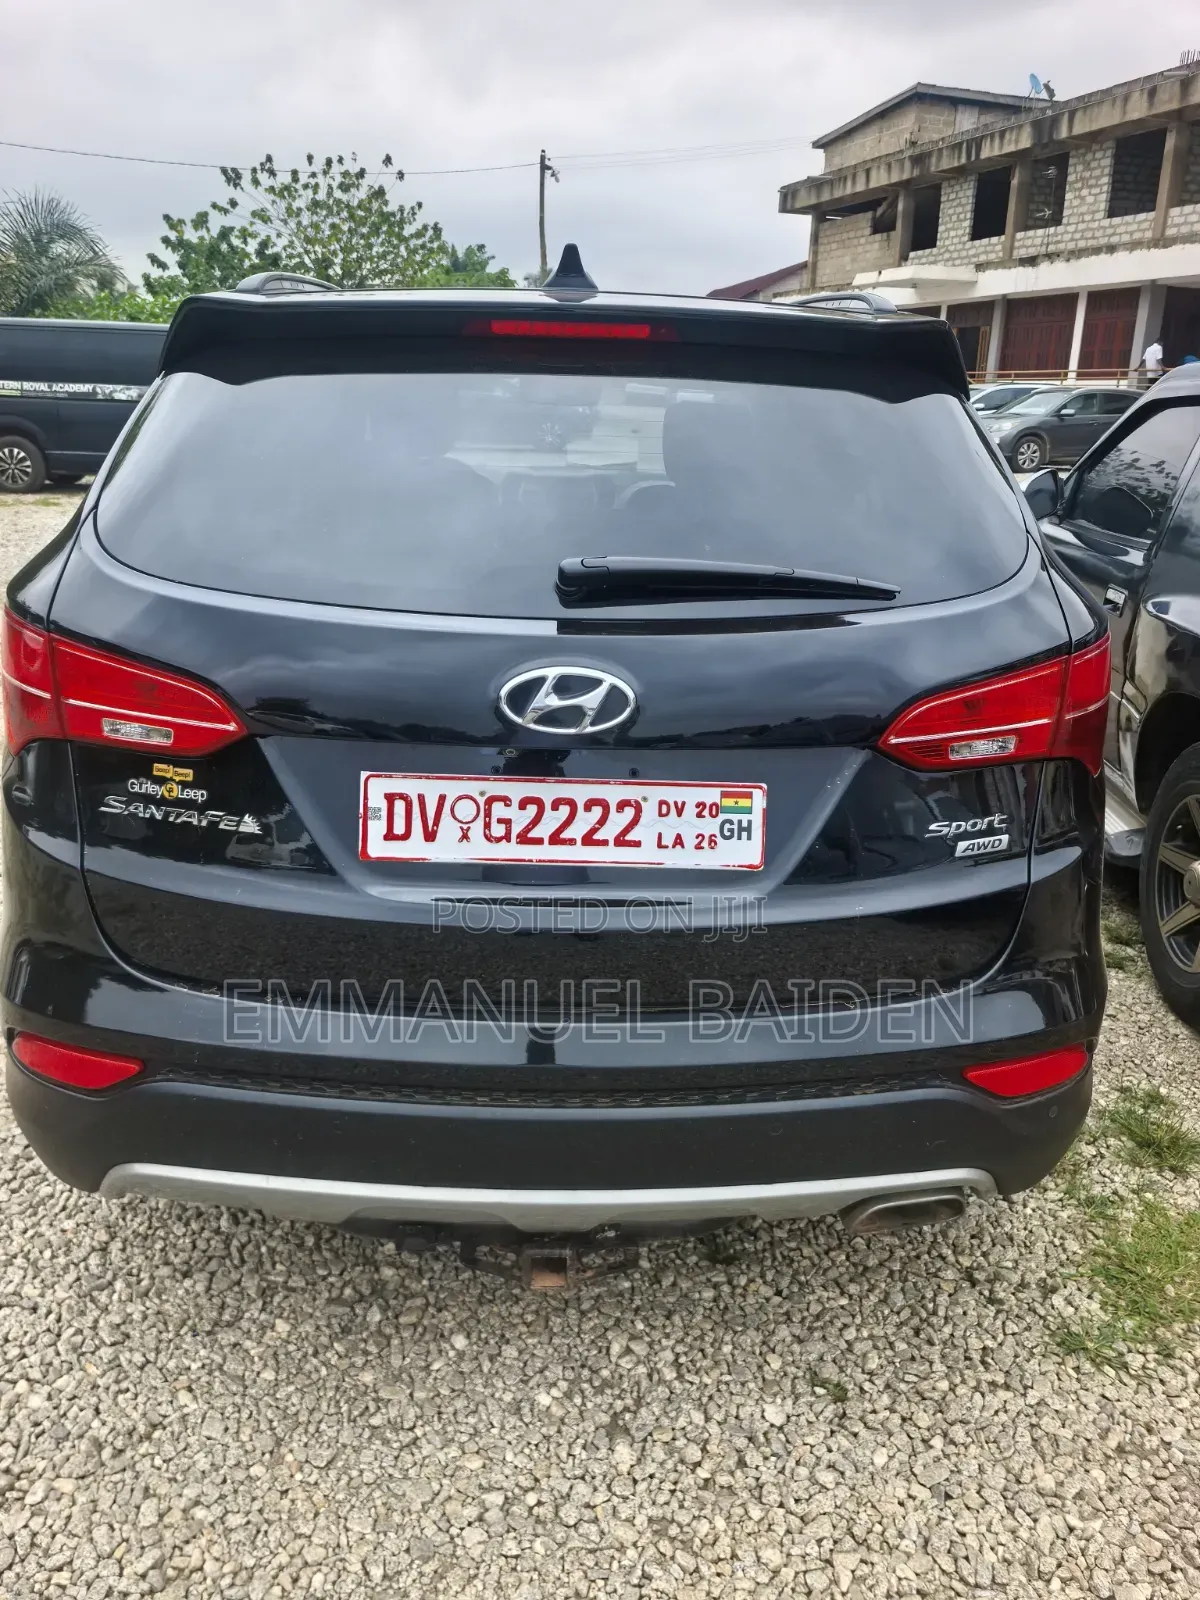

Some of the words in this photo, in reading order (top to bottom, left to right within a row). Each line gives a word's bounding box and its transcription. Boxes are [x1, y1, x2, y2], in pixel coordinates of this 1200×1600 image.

[23, 382, 51, 391] ROYAL
[52, 383, 94, 393] ACADEMY
[128, 779, 163, 798] Gurley
[178, 785, 207, 803] Leep
[383, 792, 447, 842] DV
[483, 794, 642, 847] G2222
[657, 799, 686, 818] DV
[694, 801, 720, 819] 20
[719, 818, 753, 841] GH
[924, 812, 1008, 839] Sport
[656, 831, 685, 850] LA
[694, 833, 718, 850] 26
[961, 838, 1003, 853] AWD
